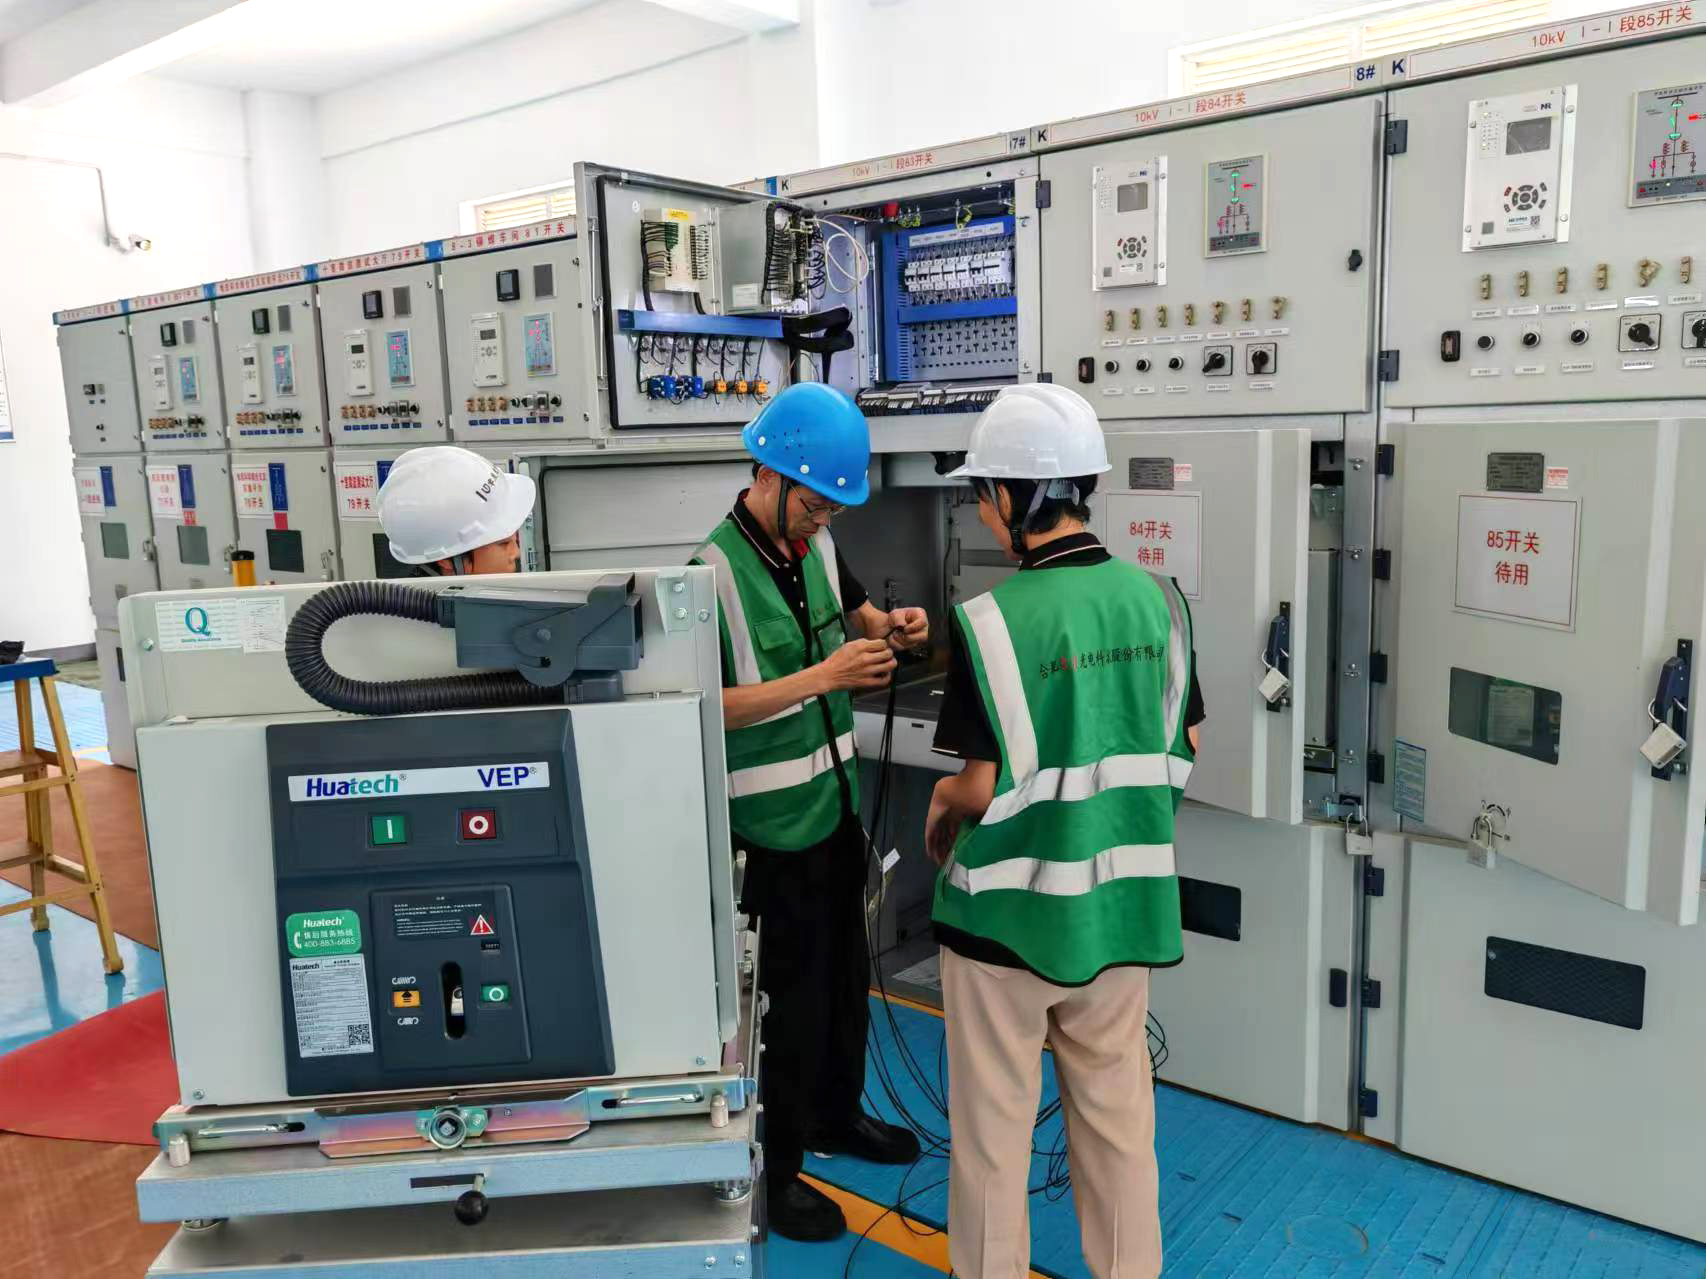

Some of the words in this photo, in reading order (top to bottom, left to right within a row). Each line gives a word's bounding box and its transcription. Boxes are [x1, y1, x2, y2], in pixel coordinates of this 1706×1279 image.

[1531, 30, 1566, 48] 10kV
[1356, 65, 1375, 81] 8#
[1391, 58, 1405, 76] K
[1135, 109, 1159, 123] 10kV
[1037, 129, 1047, 143] K
[781, 180, 789, 192] K
[1129, 520, 1173, 540] 84开关
[1487, 530, 1540, 554] 85开关
[1138, 546, 1165, 566] 待用
[1494, 560, 1529, 586] 待用
[185, 607, 211, 636] Q
[303, 917, 342, 928] Huatech
